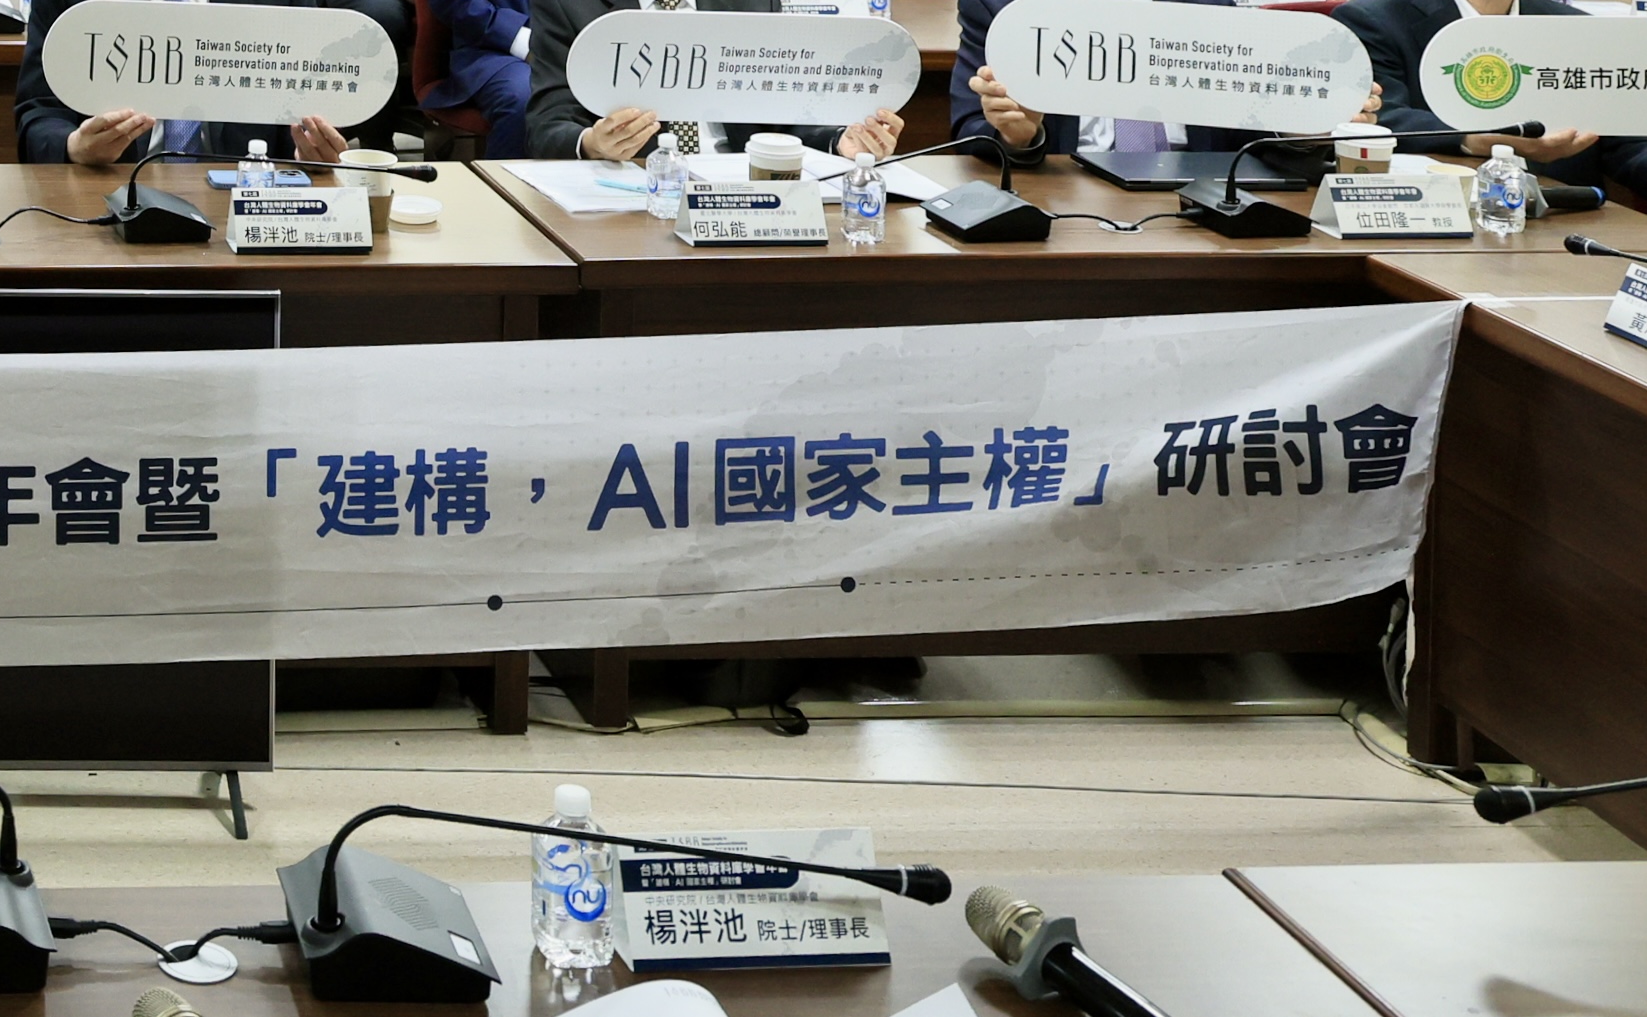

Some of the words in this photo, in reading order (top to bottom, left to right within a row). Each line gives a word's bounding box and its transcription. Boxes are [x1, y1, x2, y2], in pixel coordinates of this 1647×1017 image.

[195, 40, 231, 52] Taiwan
[234, 41, 273, 56] Society
[276, 43, 291, 54] for
[720, 46, 756, 58] Taiwan
[759, 48, 798, 61] Society
[800, 48, 815, 59] for
[1030, 26, 1137, 84] TSBB
[1149, 37, 1189, 53] Taiwan
[1191, 40, 1234, 57] Society
[1237, 43, 1254, 56] for
[84, 33, 183, 85] TSBB
[194, 56, 278, 72] Biopreservation
[280, 60, 299, 72] and
[302, 61, 360, 76] Biobanking
[610, 42, 708, 89] TSBB
[1149, 55, 1239, 72] Biopreservation
[1242, 61, 1263, 74] and
[1266, 63, 1331, 82] Biobanking
[718, 62, 801, 75] Biopreservation
[803, 64, 822, 75] and
[825, 65, 883, 79] Biobanking
[1536, 67, 1647, 90] 高雄市政
[194, 74, 358, 93] 台灣人體生物資料庫學會
[717, 79, 880, 94] 台灣人體生物資料庫學會
[1149, 73, 1330, 99] 台灣人體生物資料庫學會
[694, 220, 748, 238] 何弘能
[1356, 212, 1426, 229] 位田隆一
[1432, 218, 1454, 228] 教授
[244, 226, 298, 244] 楊泮池
[304, 232, 364, 243] 院士/理事長
[1628, 312, 1647, 334] 黃
[645, 894, 696, 904] 中央研究院
[644, 908, 748, 945] 楊泮池
[756, 916, 870, 942] 院士/理事長
